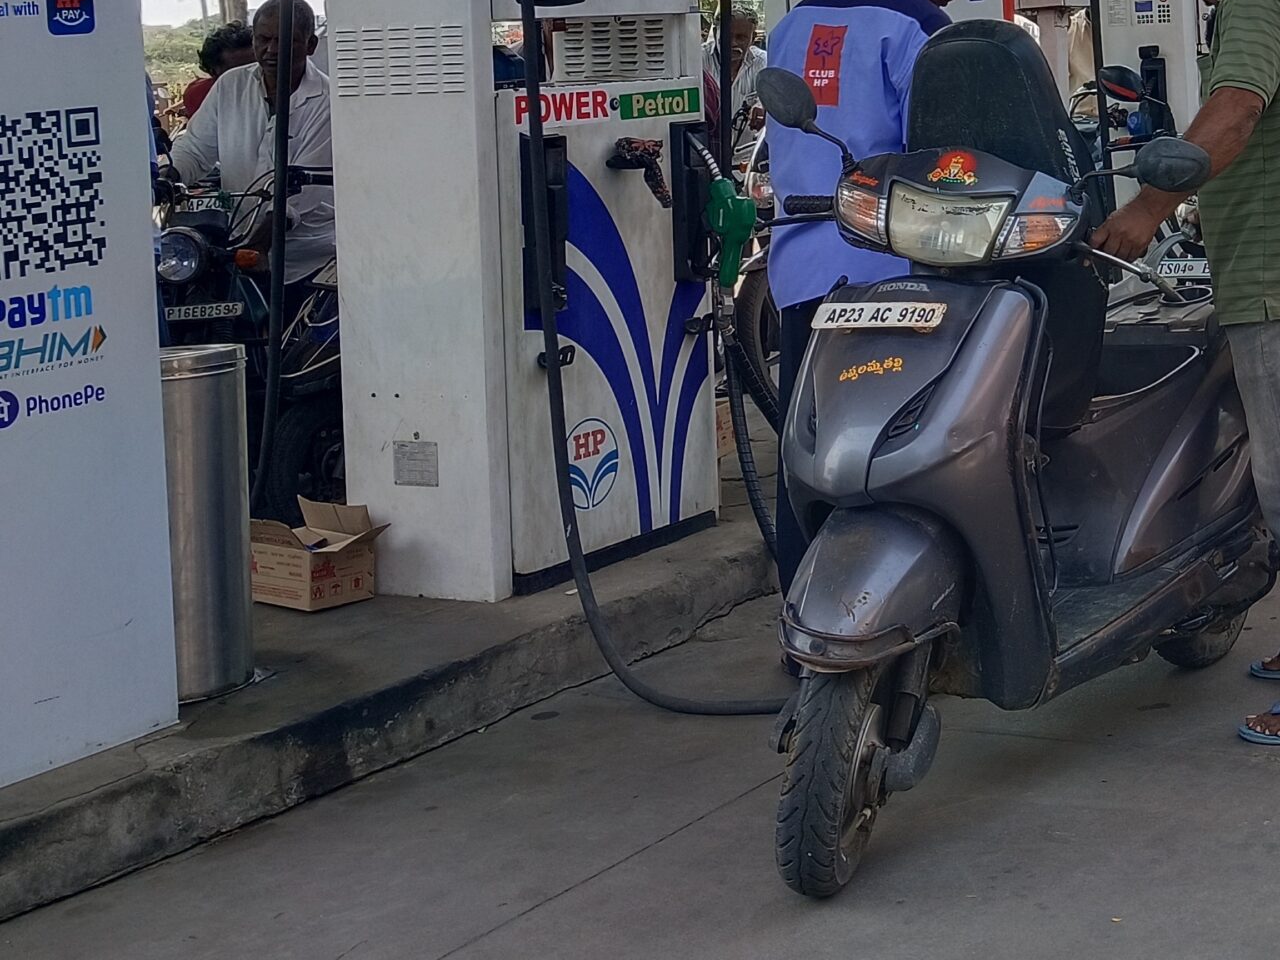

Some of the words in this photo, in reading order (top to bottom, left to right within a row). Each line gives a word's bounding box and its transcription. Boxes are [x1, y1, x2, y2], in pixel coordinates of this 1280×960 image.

[12, 1, 39, 16] with
[61, 9, 81, 20] PAY
[808, 69, 835, 78] CLUB
[813, 78, 829, 87] HP
[632, 90, 689, 117] Petrol
[1159, 262, 1188, 274] TS04
[877, 281, 930, 292] HONDA
[0, 284, 93, 329] aytm
[167, 303, 239, 320] P16EB2595
[824, 307, 864, 323] AP23
[868, 307, 892, 323] AC
[897, 307, 936, 323] 9190
[0, 326, 93, 372] BHIM
[11, 364, 55, 378] INTERFACE
[58, 361, 73, 369] FOR
[77, 355, 105, 365] MONEY
[26, 384, 105, 417] PhonePe
[572, 428, 606, 462] HP
